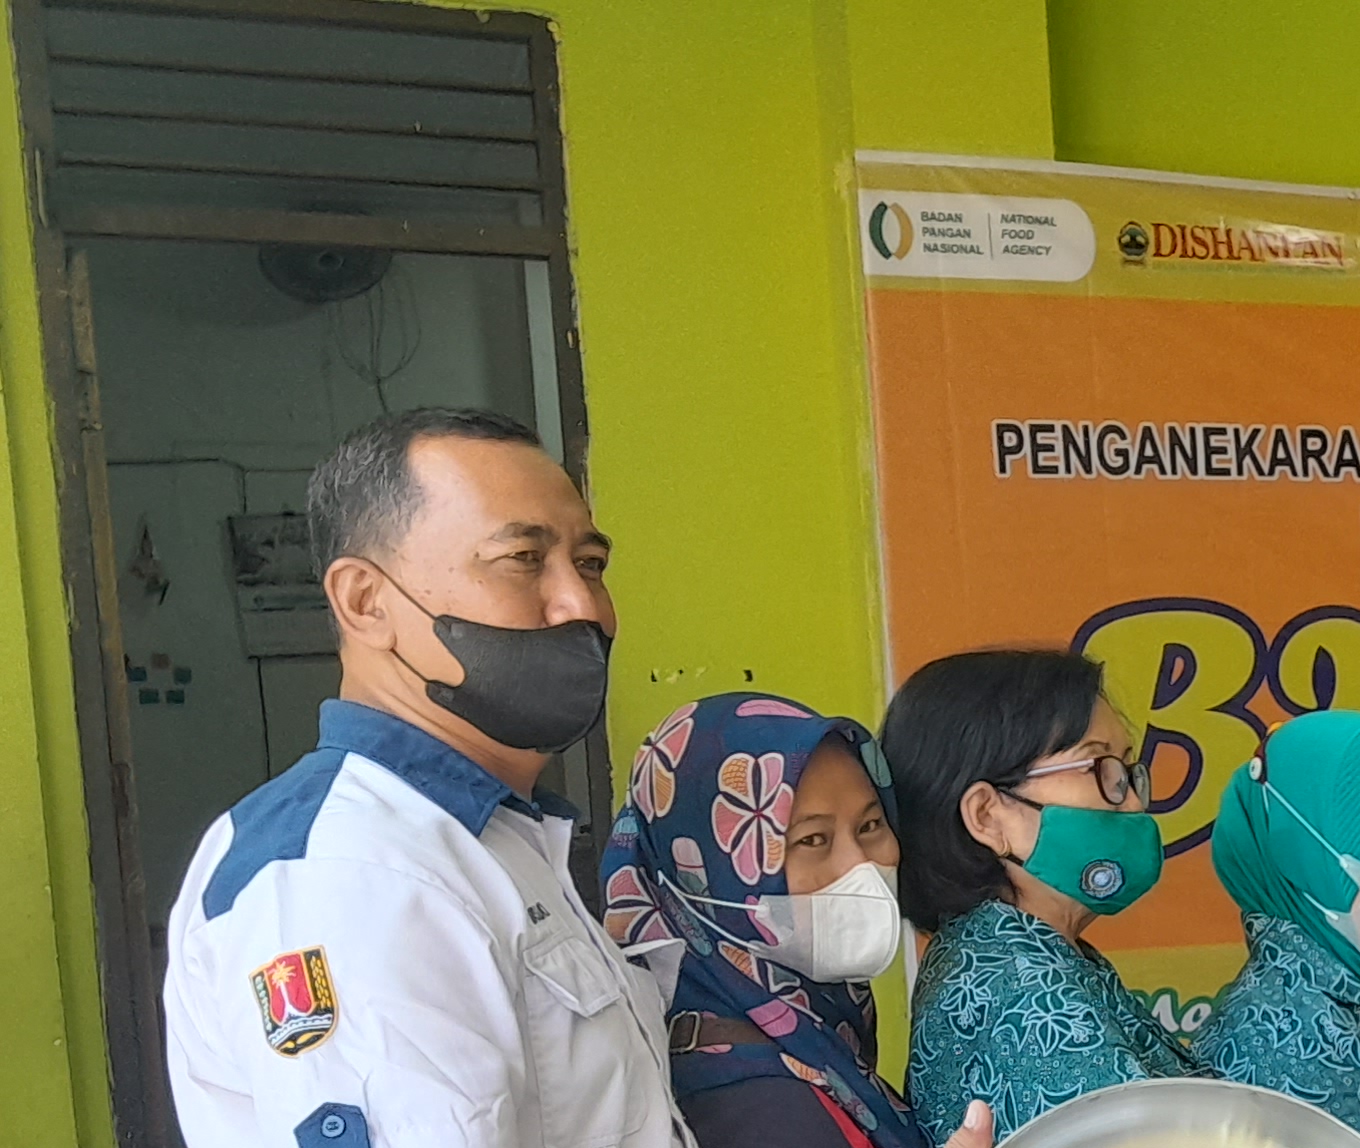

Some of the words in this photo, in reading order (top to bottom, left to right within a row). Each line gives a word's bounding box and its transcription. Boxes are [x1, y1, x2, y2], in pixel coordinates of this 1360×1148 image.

[920, 211, 963, 223] BADAN
[1000, 213, 1057, 227] NATIONAL
[921, 226, 972, 239] PANGAN
[1001, 228, 1035, 240] FOOD
[922, 242, 985, 255] NASIONAL
[1002, 244, 1052, 257] AGENCY
